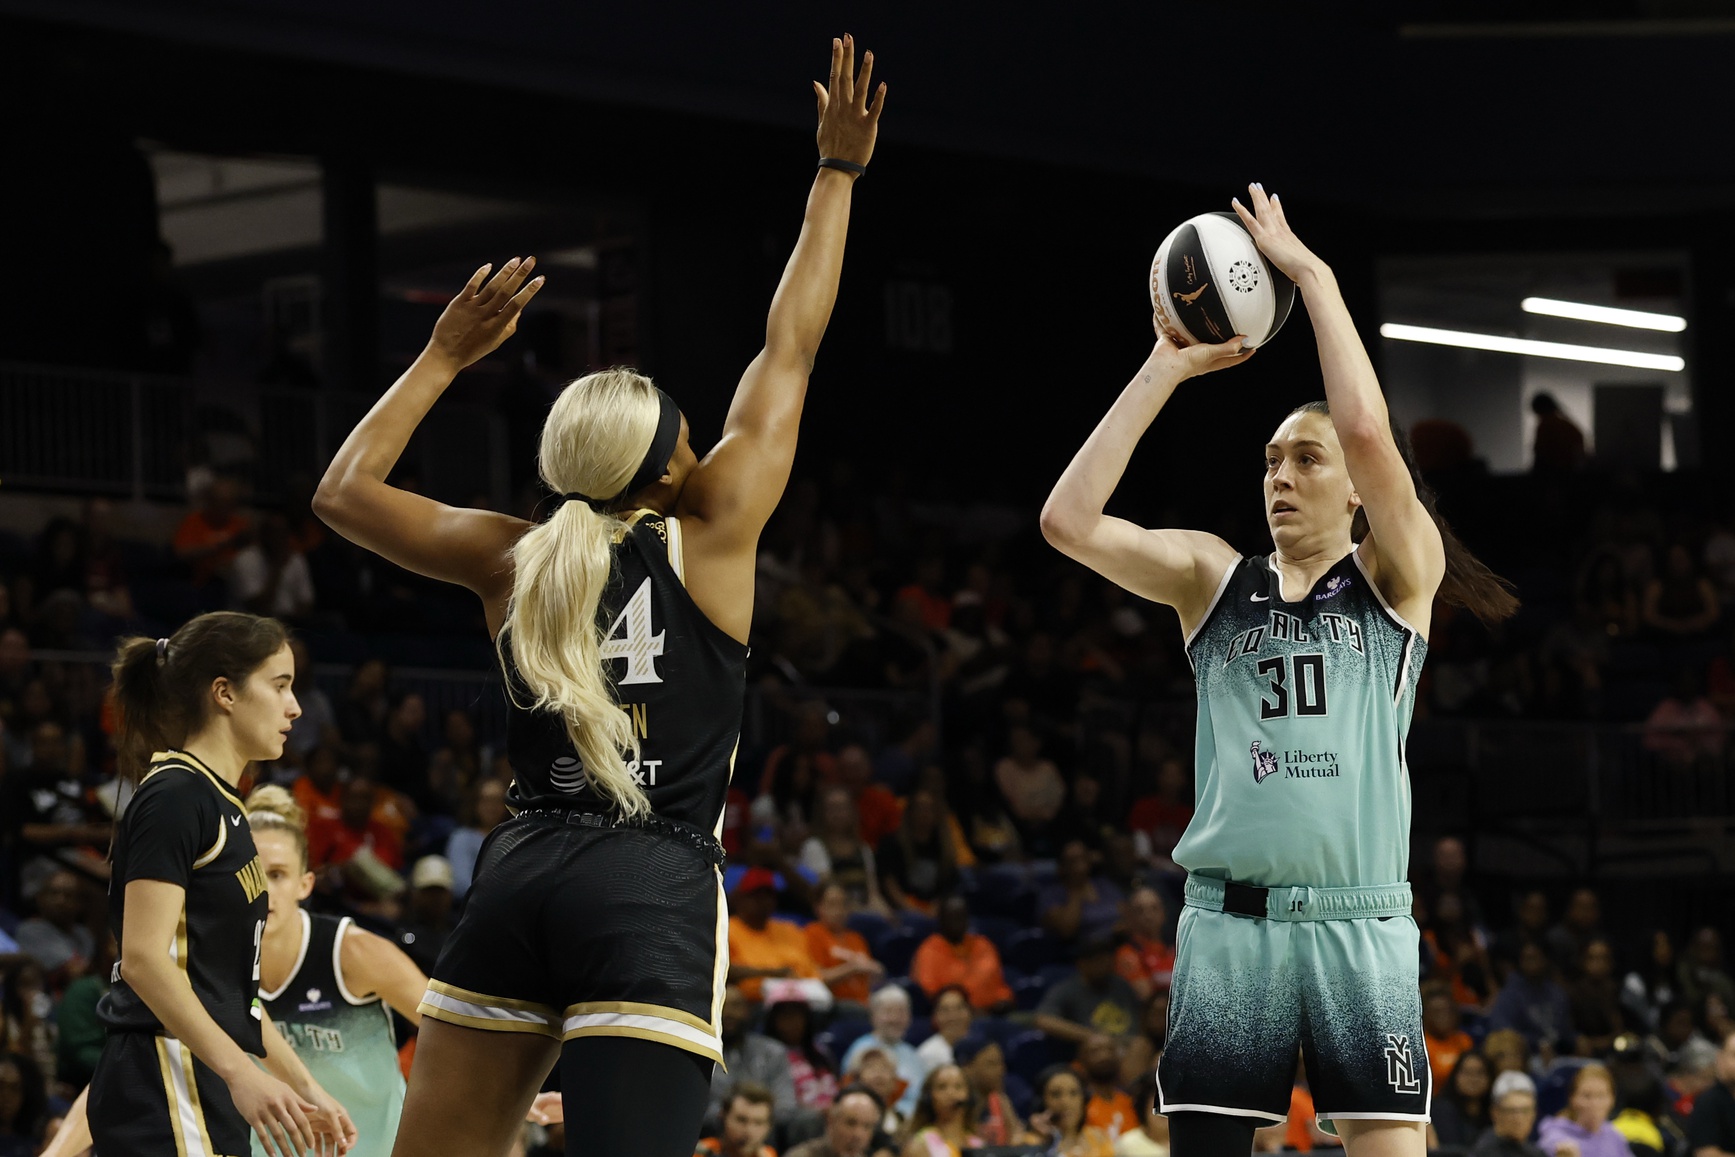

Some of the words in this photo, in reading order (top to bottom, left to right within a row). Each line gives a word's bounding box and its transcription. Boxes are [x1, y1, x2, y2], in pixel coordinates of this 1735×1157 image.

[1315, 578, 1352, 601] BARCLAYS
[1256, 652, 1329, 721] 30
[1284, 750, 1338, 768] Liberty
[1284, 764, 1340, 779] Mutual
